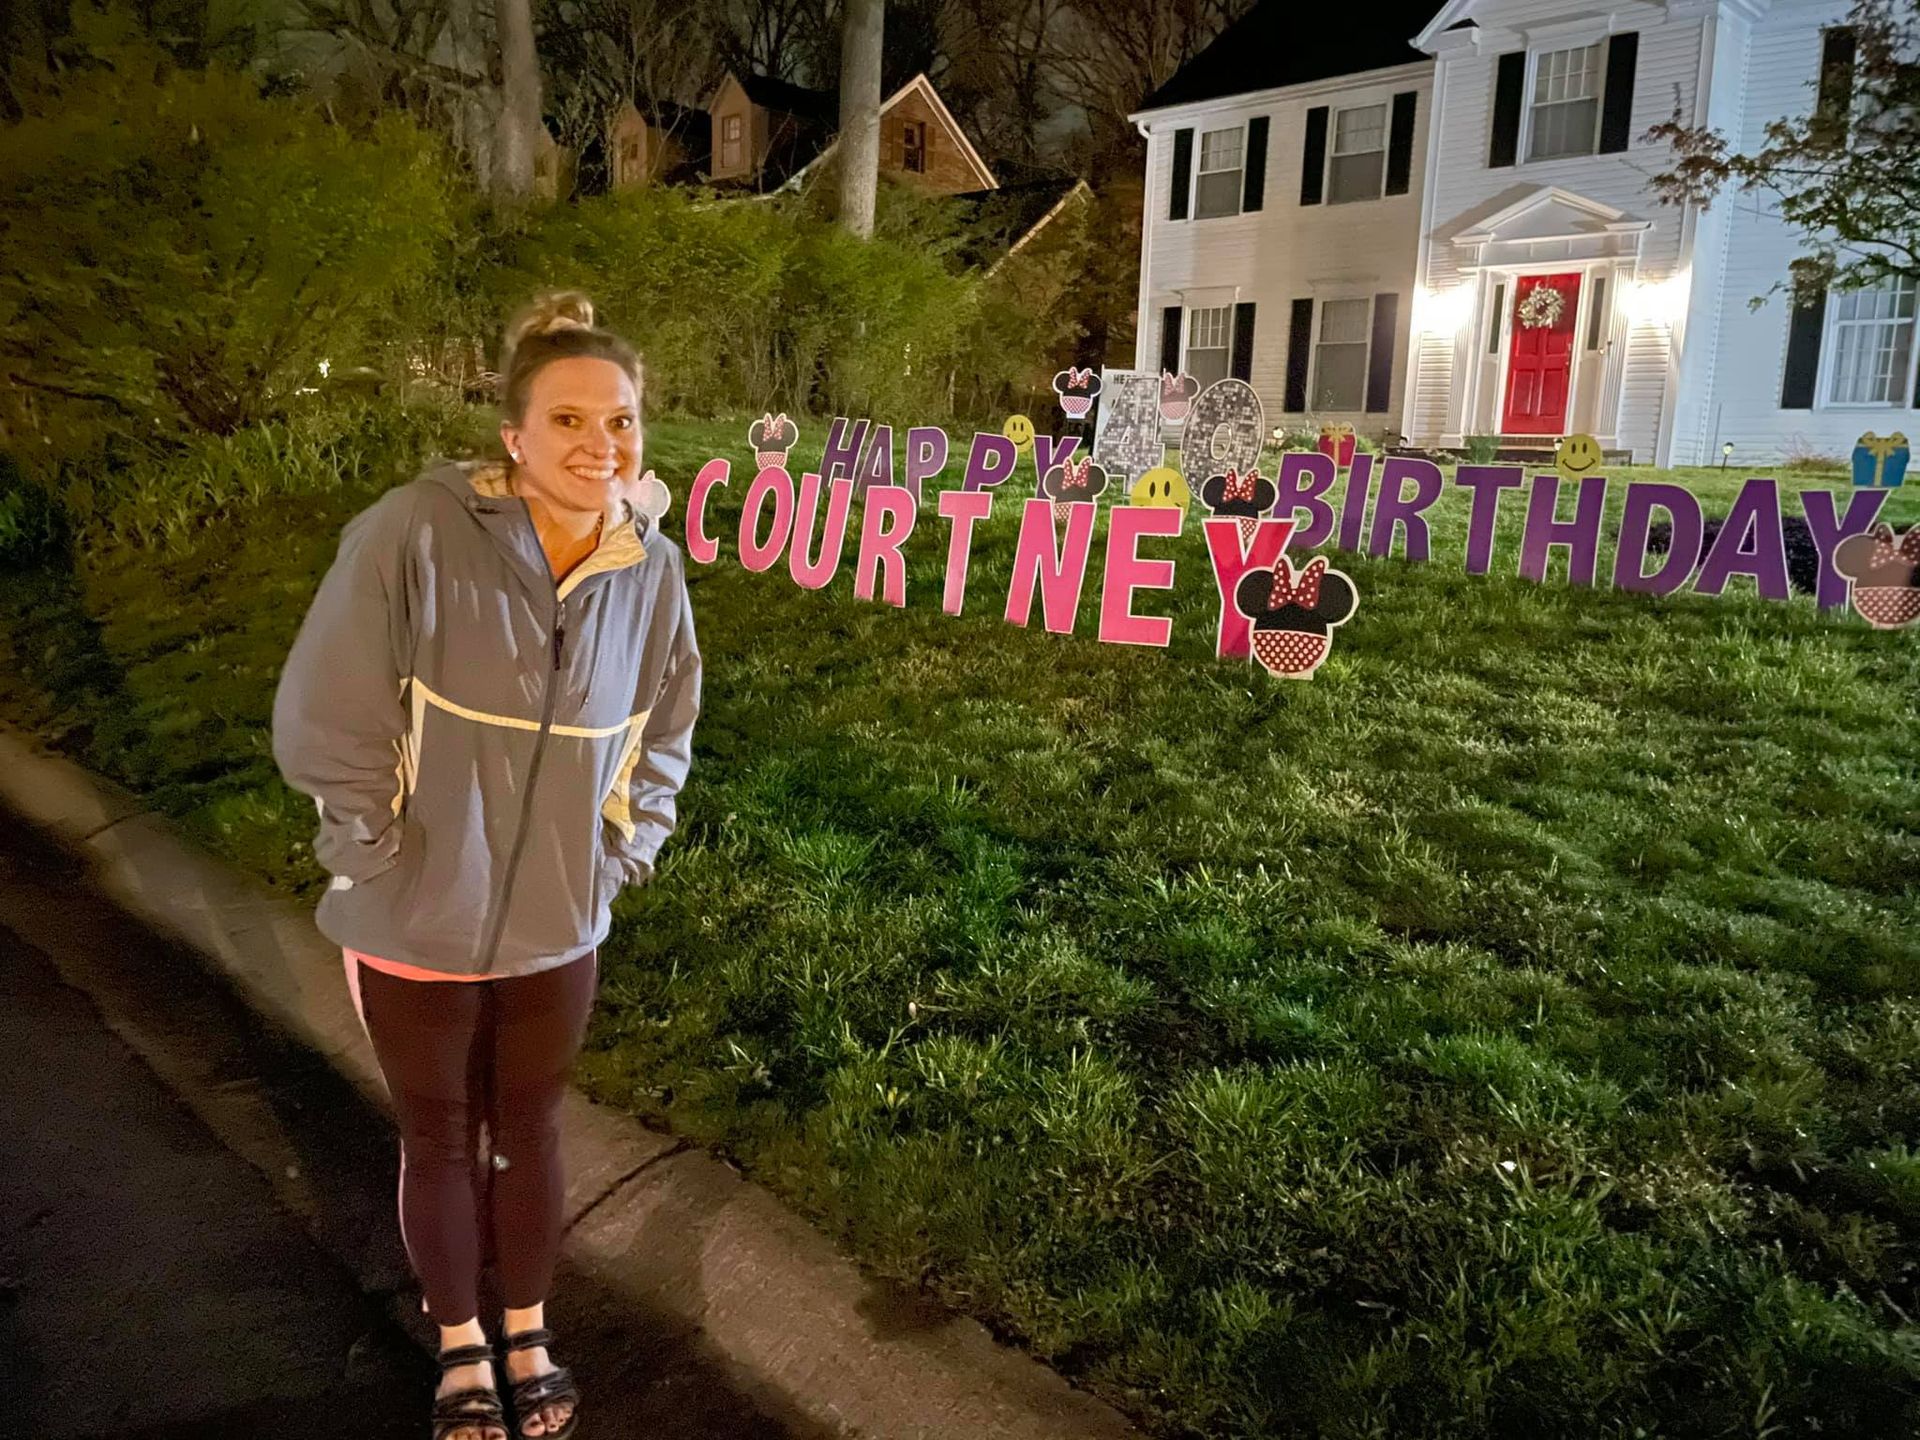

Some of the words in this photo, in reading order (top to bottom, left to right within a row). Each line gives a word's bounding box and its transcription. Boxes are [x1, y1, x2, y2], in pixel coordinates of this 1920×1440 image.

[820, 417, 1082, 505] HAPPY
[1270, 452, 1892, 612] BIRTHDAY
[1097, 376, 1265, 501] 40
[685, 458, 1298, 660] COURTNEY
